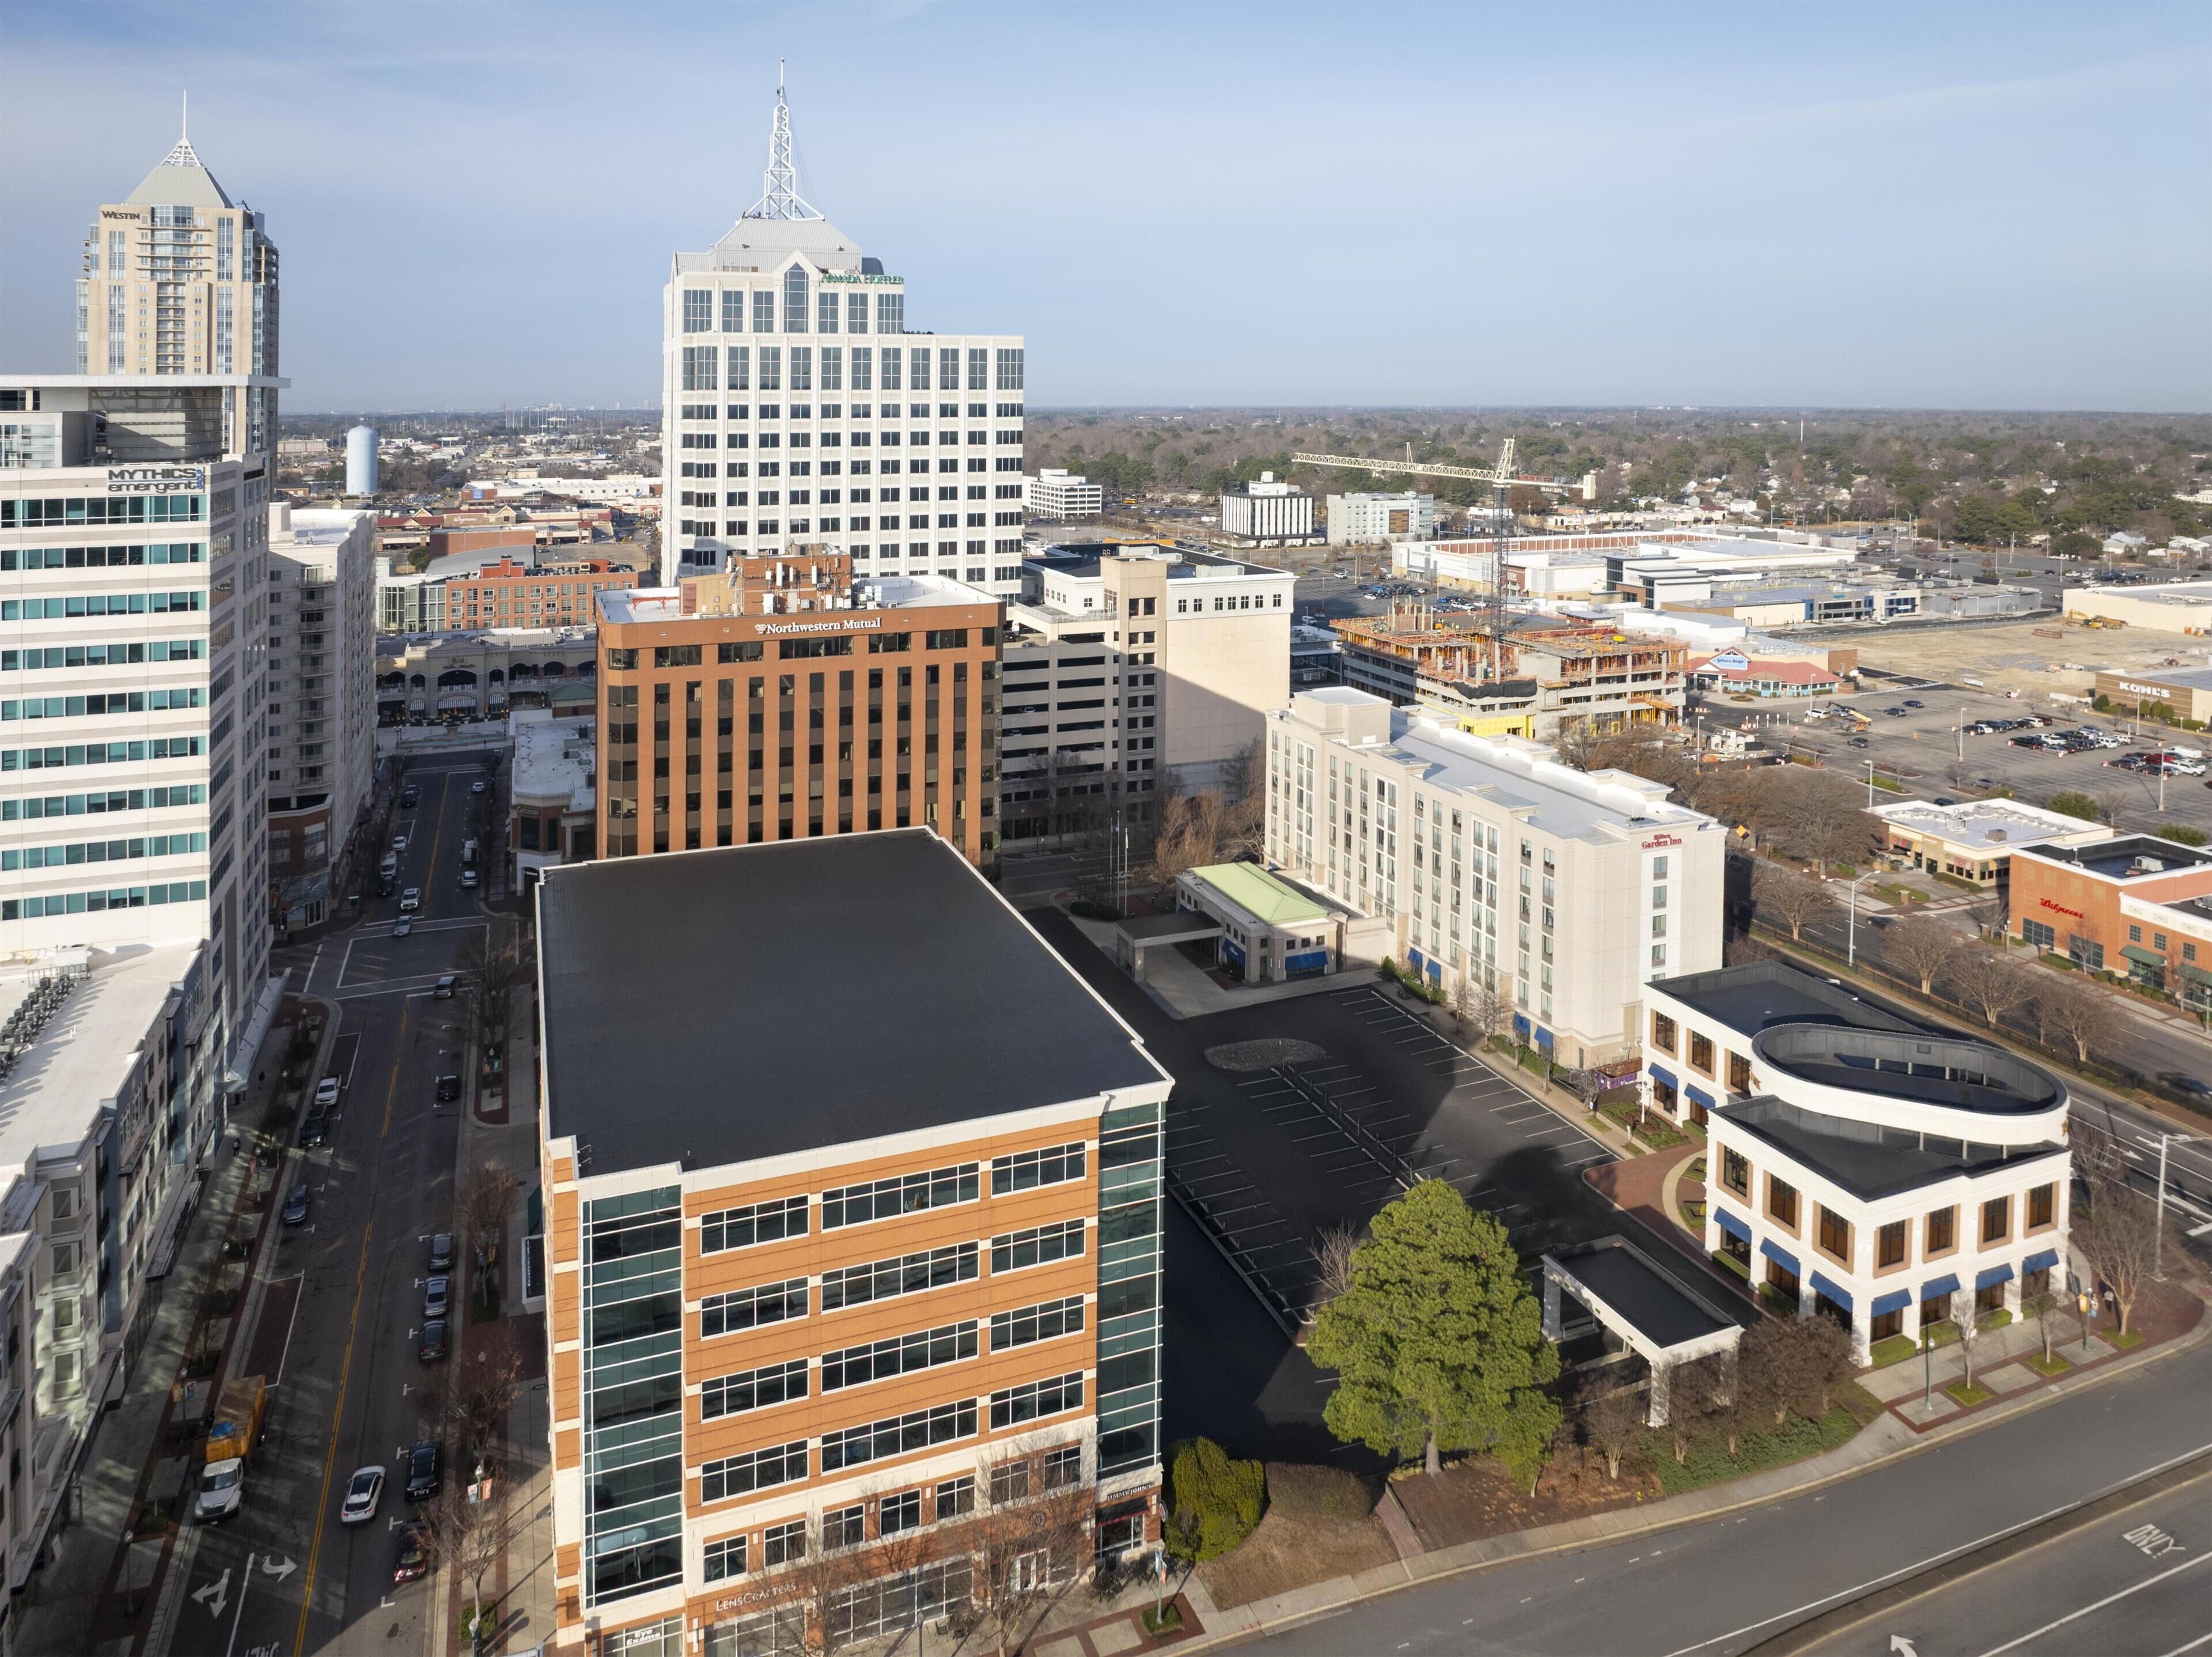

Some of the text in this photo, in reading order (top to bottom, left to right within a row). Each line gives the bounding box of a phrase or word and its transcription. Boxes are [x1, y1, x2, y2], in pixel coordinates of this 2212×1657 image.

[101, 210, 141, 220] WESTIN
[821, 273, 862, 283] ARMADA
[108, 468, 196, 480] MYTHICS
[108, 481, 196, 493] emergent
[766, 617, 881, 634] Northwestern Mutual
[2119, 682, 2171, 699] KOHL'S
[1642, 839, 1668, 849] Garden
[2039, 898, 2084, 919] Walgreens
[1107, 1489, 1130, 1501] JIMMY
[2122, 1523, 2187, 1560] ONLY
[626, 1632, 661, 1646] Exams
[635, 1629, 653, 1639] Eye
